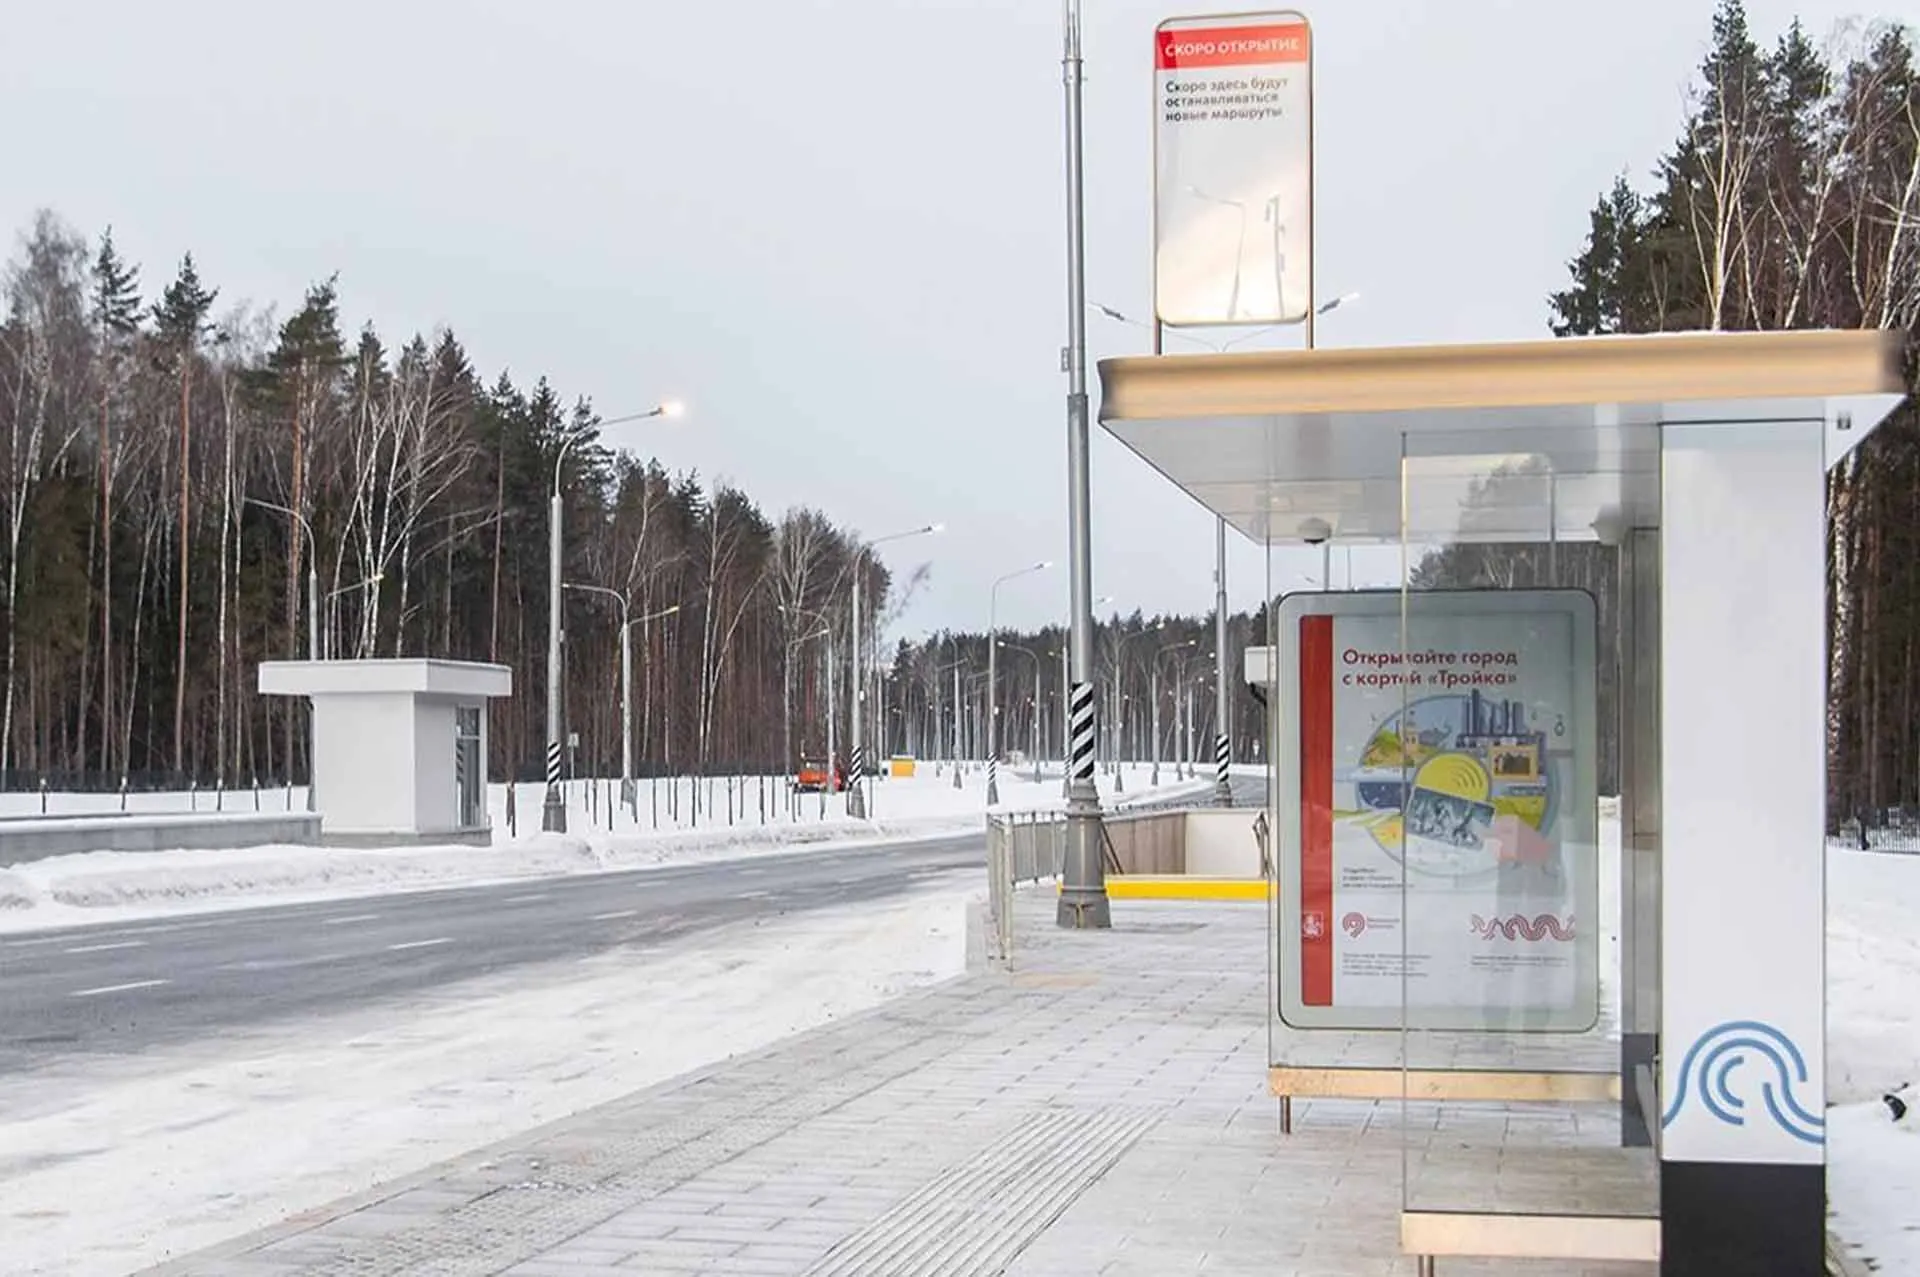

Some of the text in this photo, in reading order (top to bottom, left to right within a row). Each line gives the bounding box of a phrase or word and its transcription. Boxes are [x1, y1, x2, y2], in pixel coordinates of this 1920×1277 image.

[1165, 38, 1299, 57] СКОРО ОТКРЫТИЕ
[1165, 76, 1289, 93] Скоро здесь будут
[1165, 93, 1279, 107] останавливаться
[1165, 107, 1282, 121] новые маршруты
[1462, 652, 1518, 668] город
[1342, 676, 1351, 685] с
[1428, 669, 1517, 688] «Тройка»
